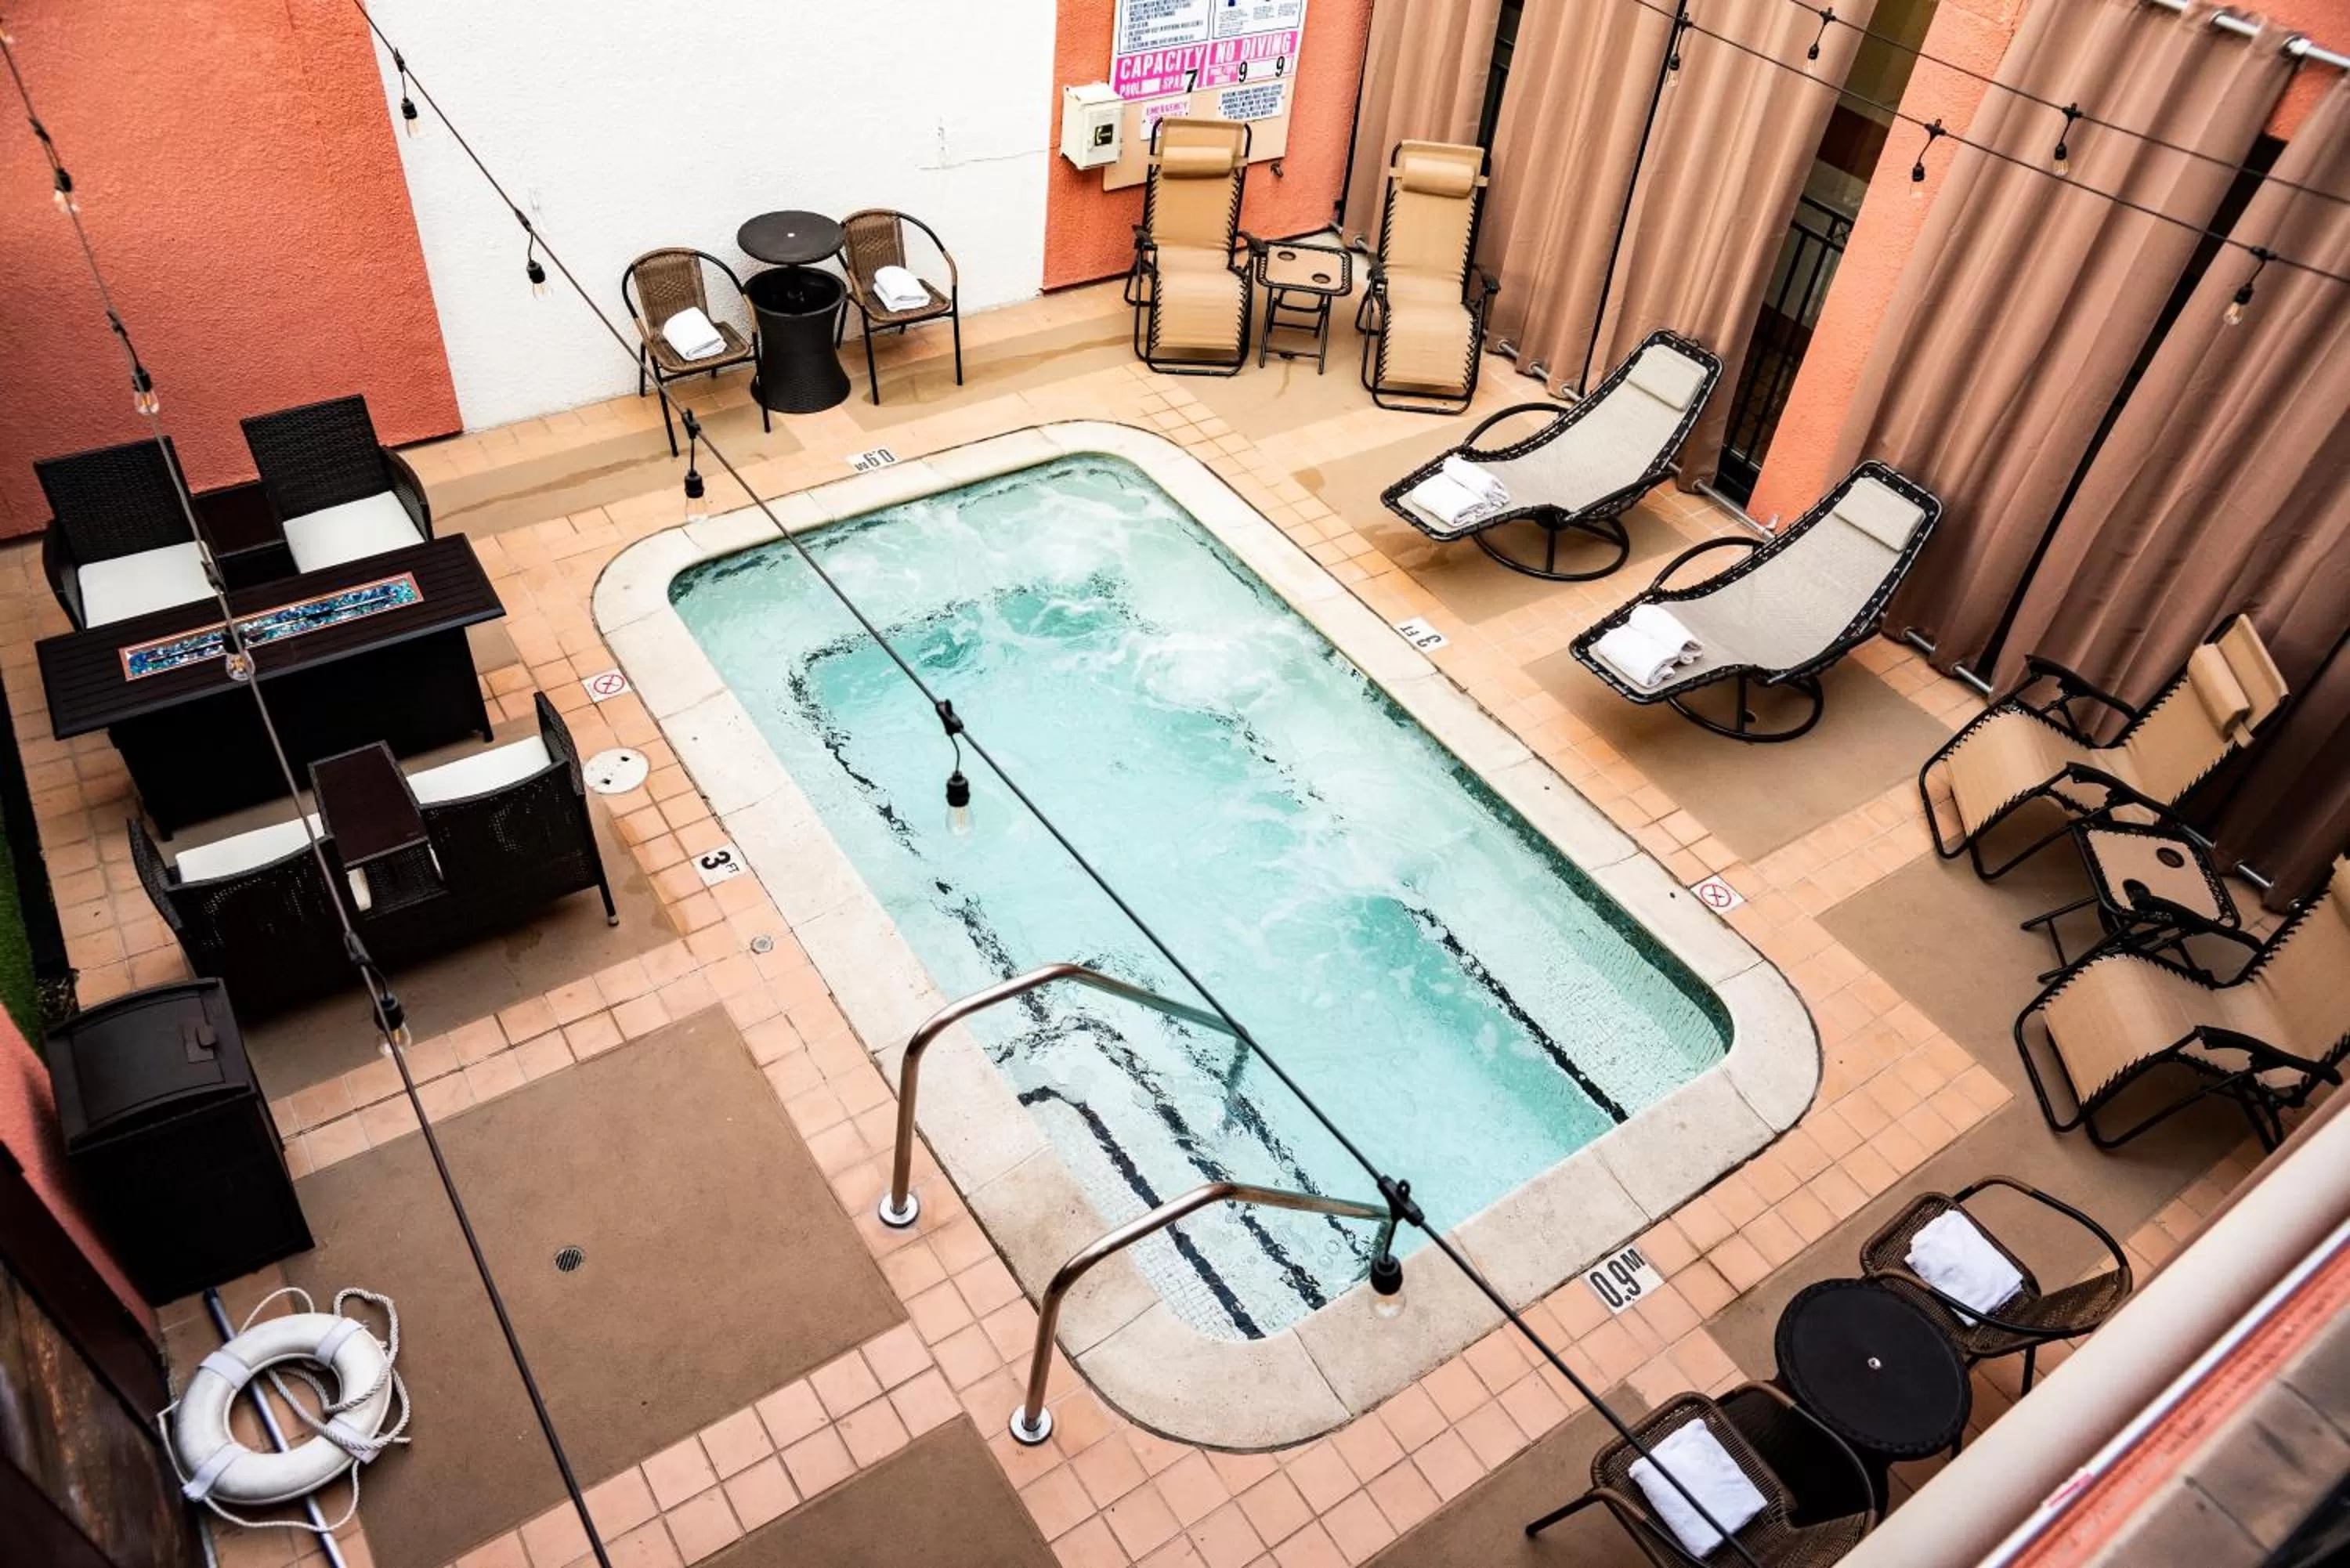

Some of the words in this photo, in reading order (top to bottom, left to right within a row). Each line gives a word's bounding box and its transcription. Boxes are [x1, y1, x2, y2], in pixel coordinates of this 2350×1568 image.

[1120, 45, 1205, 80] CAPACITY
[1215, 41, 1236, 64] NO
[1239, 32, 1292, 60] DIVING
[1119, 80, 1141, 97] POOL
[1185, 69, 1198, 93] 7
[1238, 61, 1248, 83] 9
[1274, 56, 1285, 78] 9
